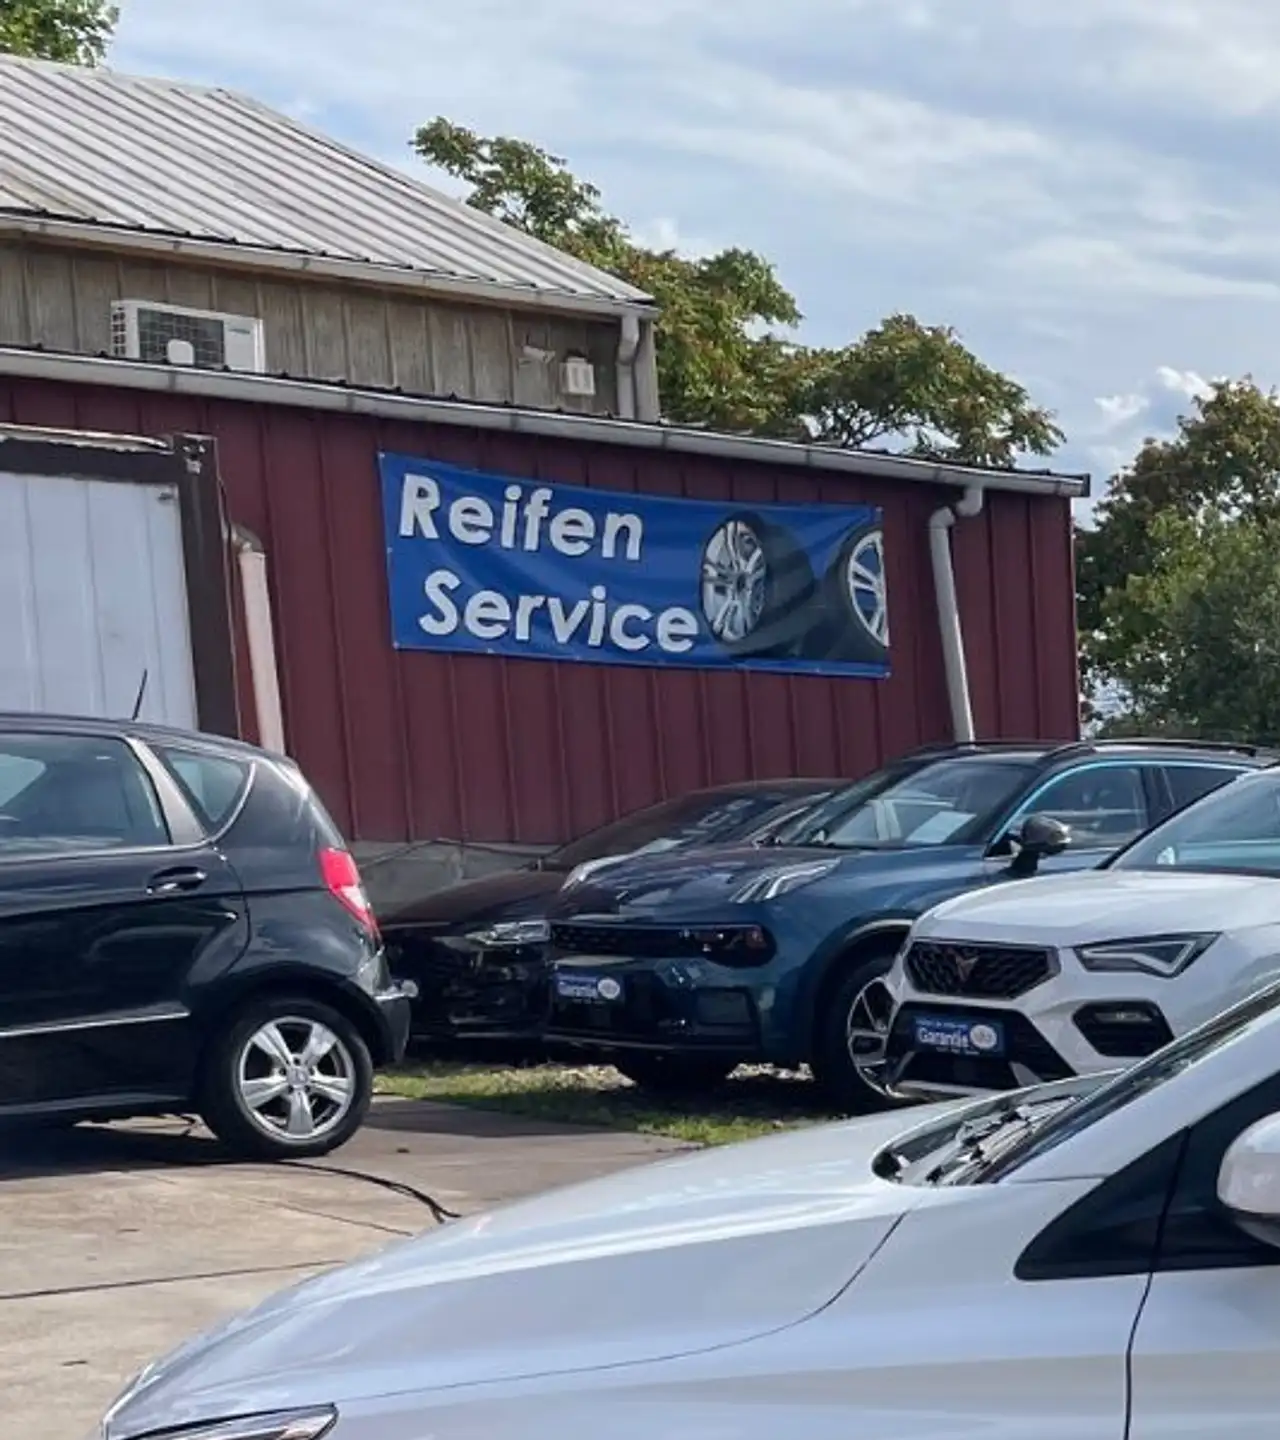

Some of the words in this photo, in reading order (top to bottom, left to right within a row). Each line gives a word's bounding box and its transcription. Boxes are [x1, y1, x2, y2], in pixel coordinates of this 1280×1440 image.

[399, 472, 644, 561] Reifen
[418, 569, 700, 653] Service
[917, 1026, 970, 1049] Garantie
